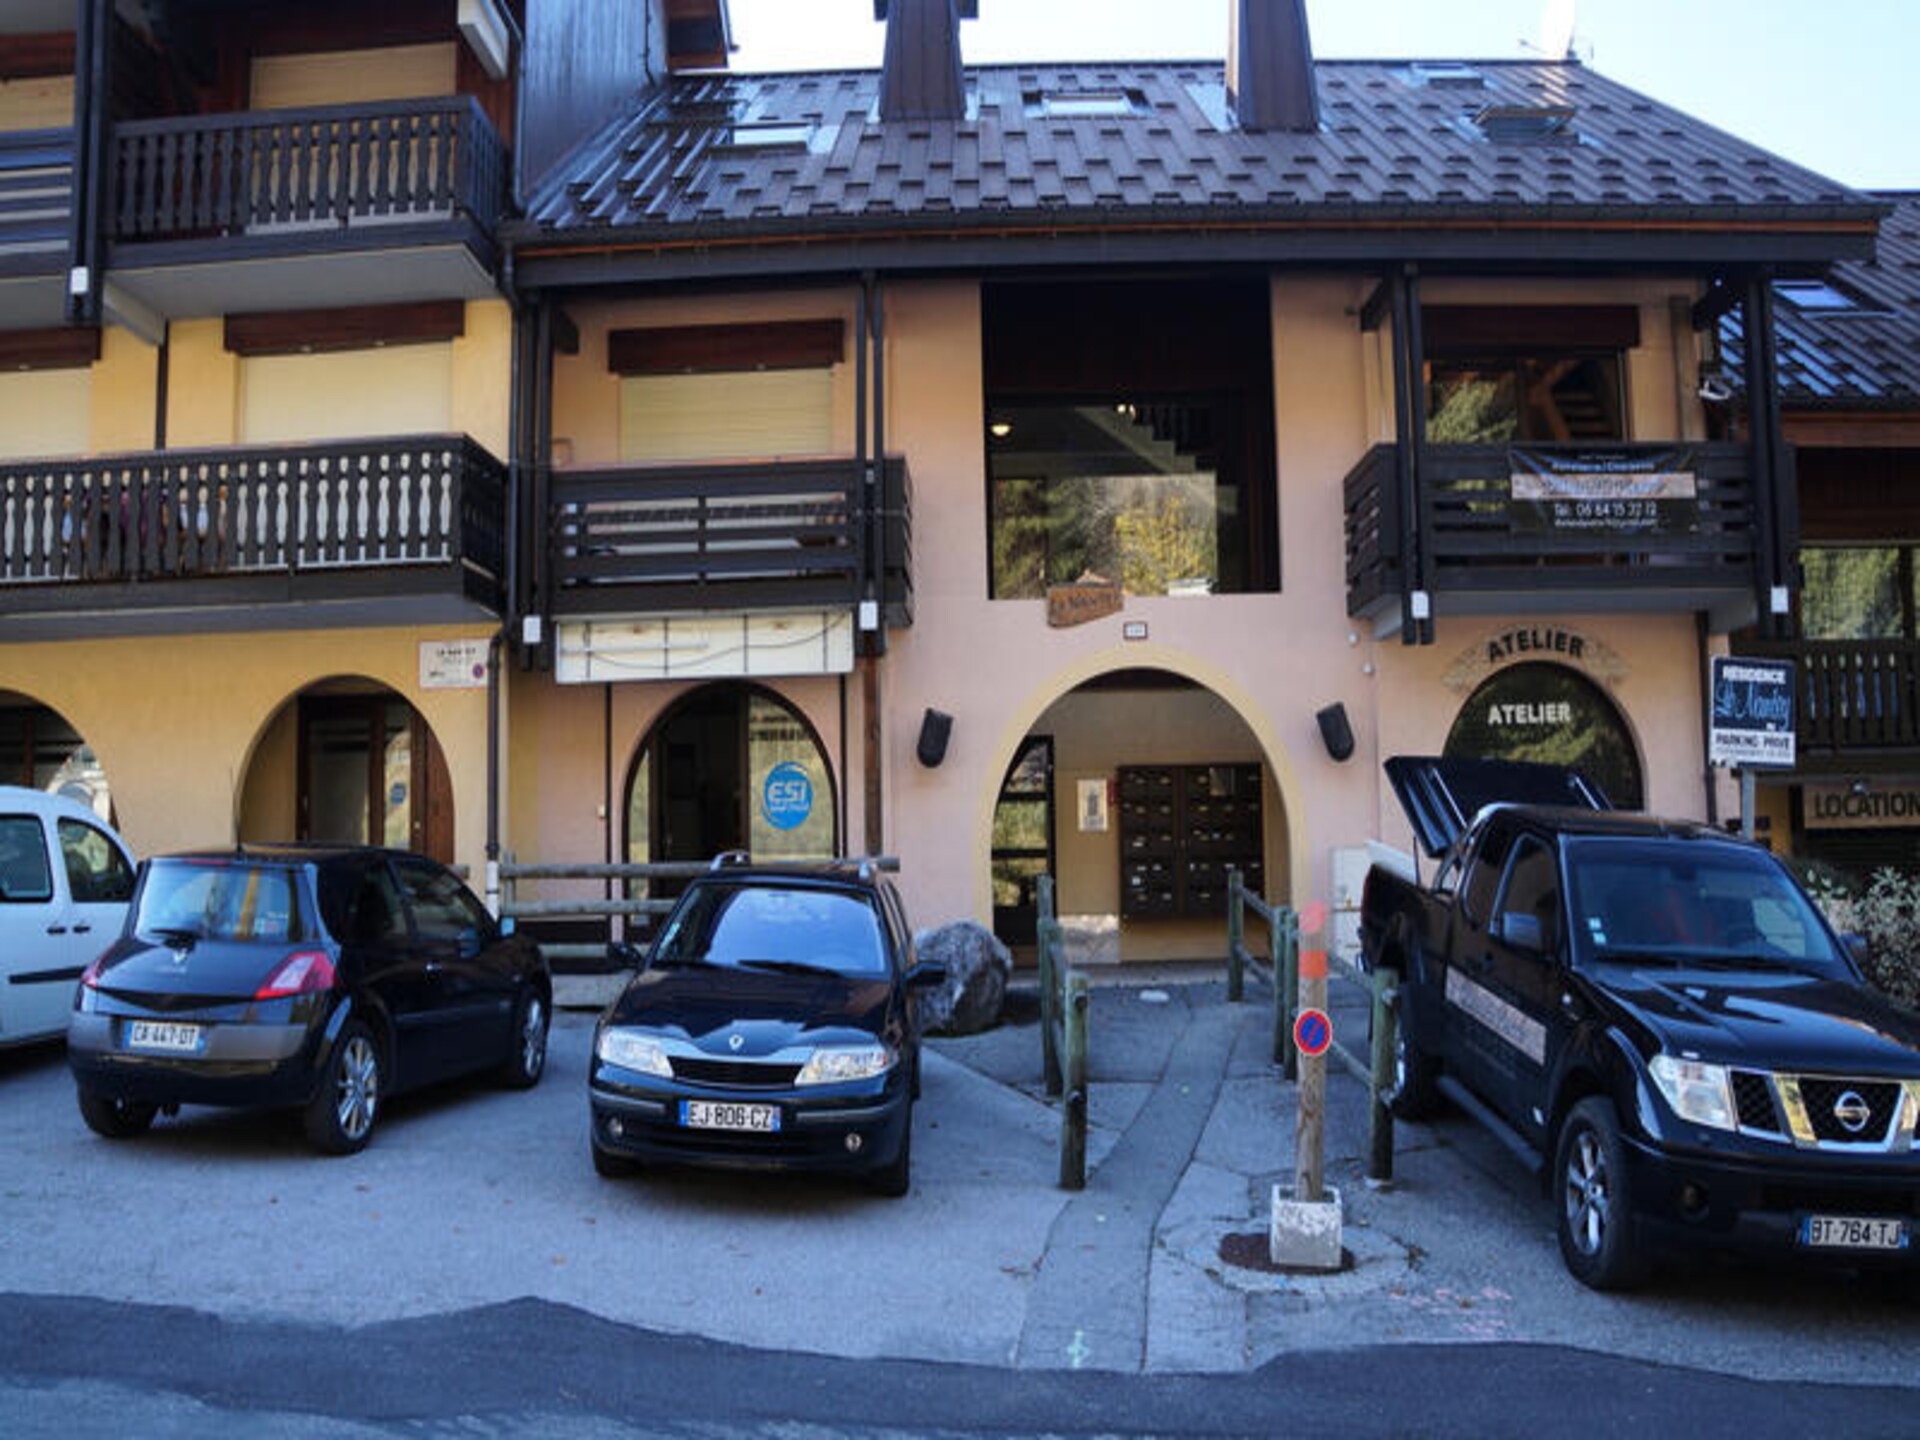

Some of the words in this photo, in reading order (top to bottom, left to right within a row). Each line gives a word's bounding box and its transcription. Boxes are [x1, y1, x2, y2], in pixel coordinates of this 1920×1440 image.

[1489, 628, 1584, 663] ATELIER
[1487, 703, 1572, 725] ATELIER
[1715, 733, 1759, 748] PARKING
